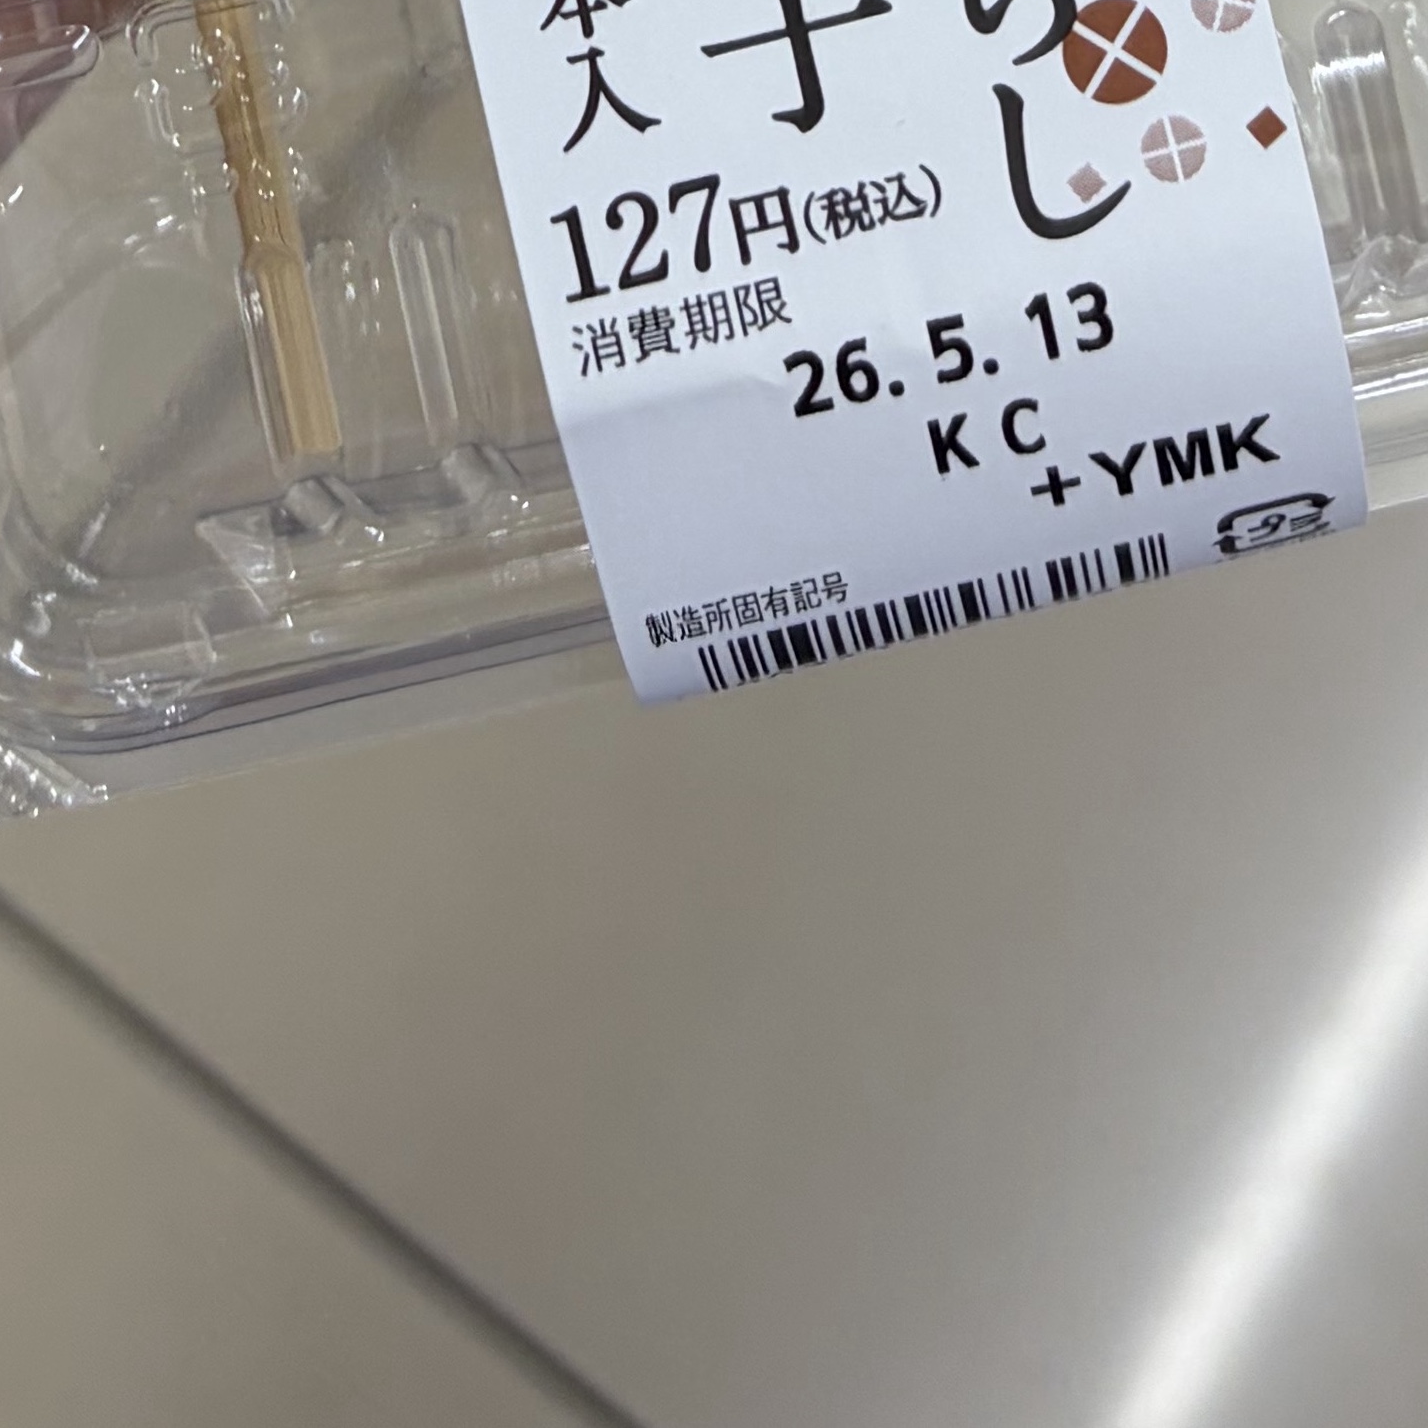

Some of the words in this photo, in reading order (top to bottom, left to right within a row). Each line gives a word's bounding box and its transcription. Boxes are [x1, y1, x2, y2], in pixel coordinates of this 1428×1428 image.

[571, 275, 793, 378] 消費期限
[644, 570, 849, 648] 製造所固有記号
